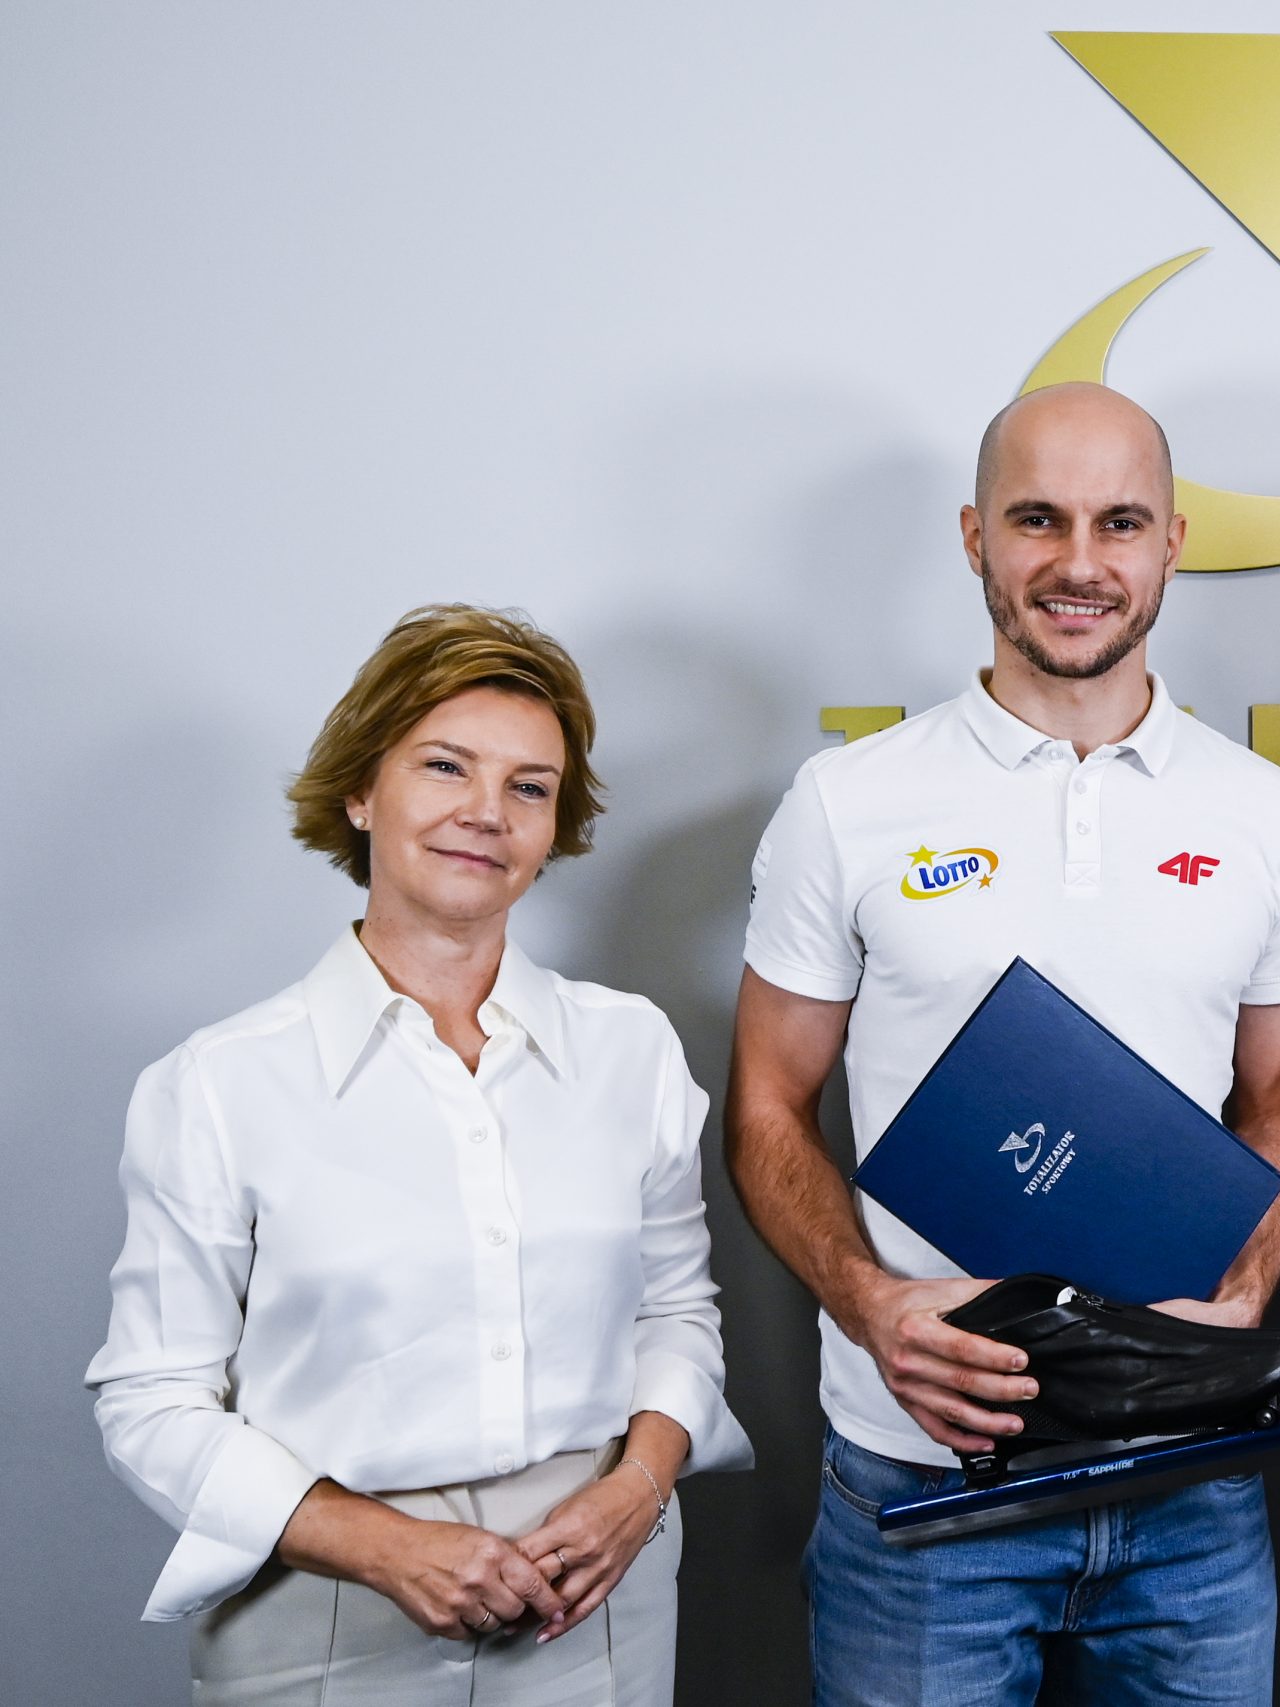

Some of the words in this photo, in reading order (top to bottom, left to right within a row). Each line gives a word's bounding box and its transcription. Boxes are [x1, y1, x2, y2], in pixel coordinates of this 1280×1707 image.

[918, 856, 980, 890] LOTTO
[1158, 851, 1221, 886] 4F
[1023, 1130, 1075, 1196] TOTALIZATOR
[1041, 1148, 1076, 1194] SPORTOWY
[1088, 1459, 1135, 1477] SAPPHIRE
